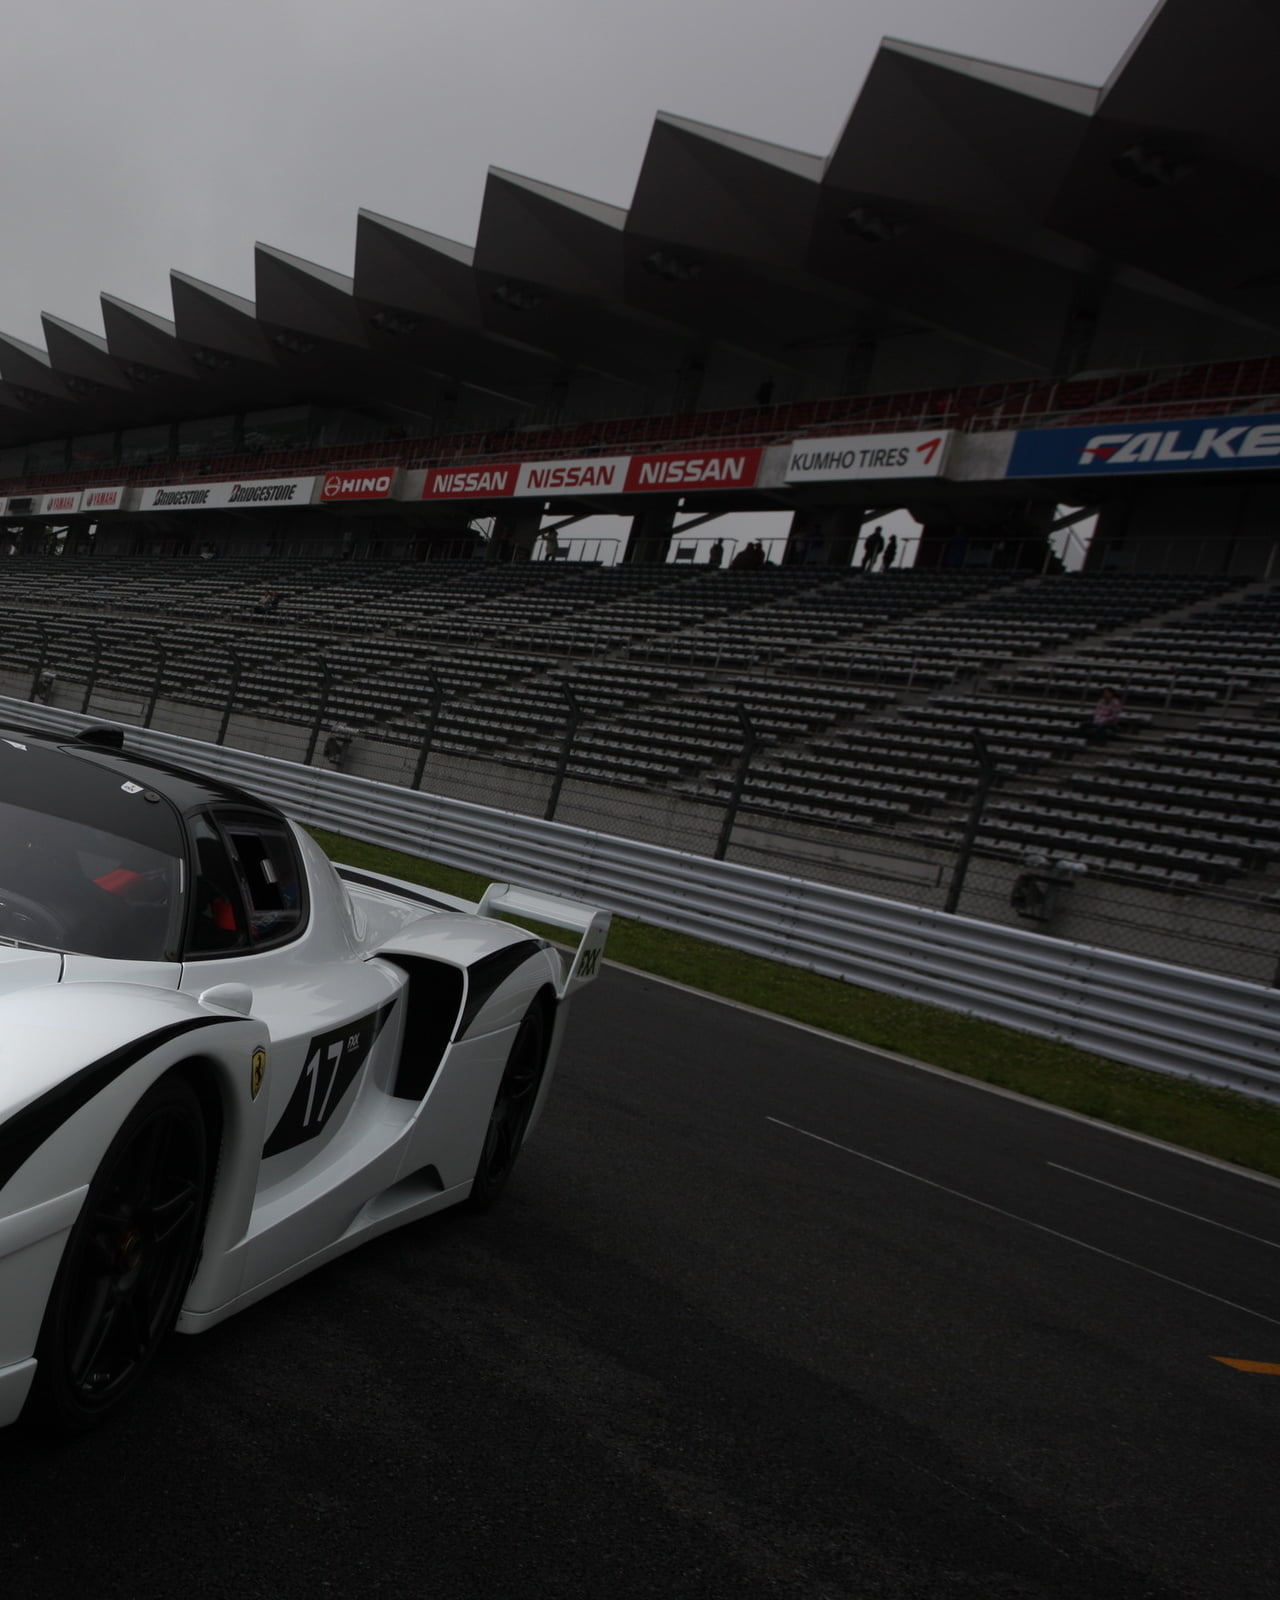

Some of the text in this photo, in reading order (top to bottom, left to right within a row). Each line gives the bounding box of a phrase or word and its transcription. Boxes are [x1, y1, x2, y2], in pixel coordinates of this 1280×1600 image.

[1078, 424, 1280, 465] FALKE
[638, 456, 746, 484] NISSAN
[790, 447, 909, 472] KUMHO TIRES
[340, 476, 391, 493] HINO
[432, 471, 508, 493] NISSAN
[527, 465, 615, 489] NISSAN
[52, 497, 75, 510] YAMAHA
[92, 491, 118, 506] YAMAHA
[153, 489, 211, 506] BRIDGESTONE
[229, 483, 297, 502] BRIDGESTONE
[577, 948, 601, 977] FXX
[303, 1040, 344, 1127] 17
